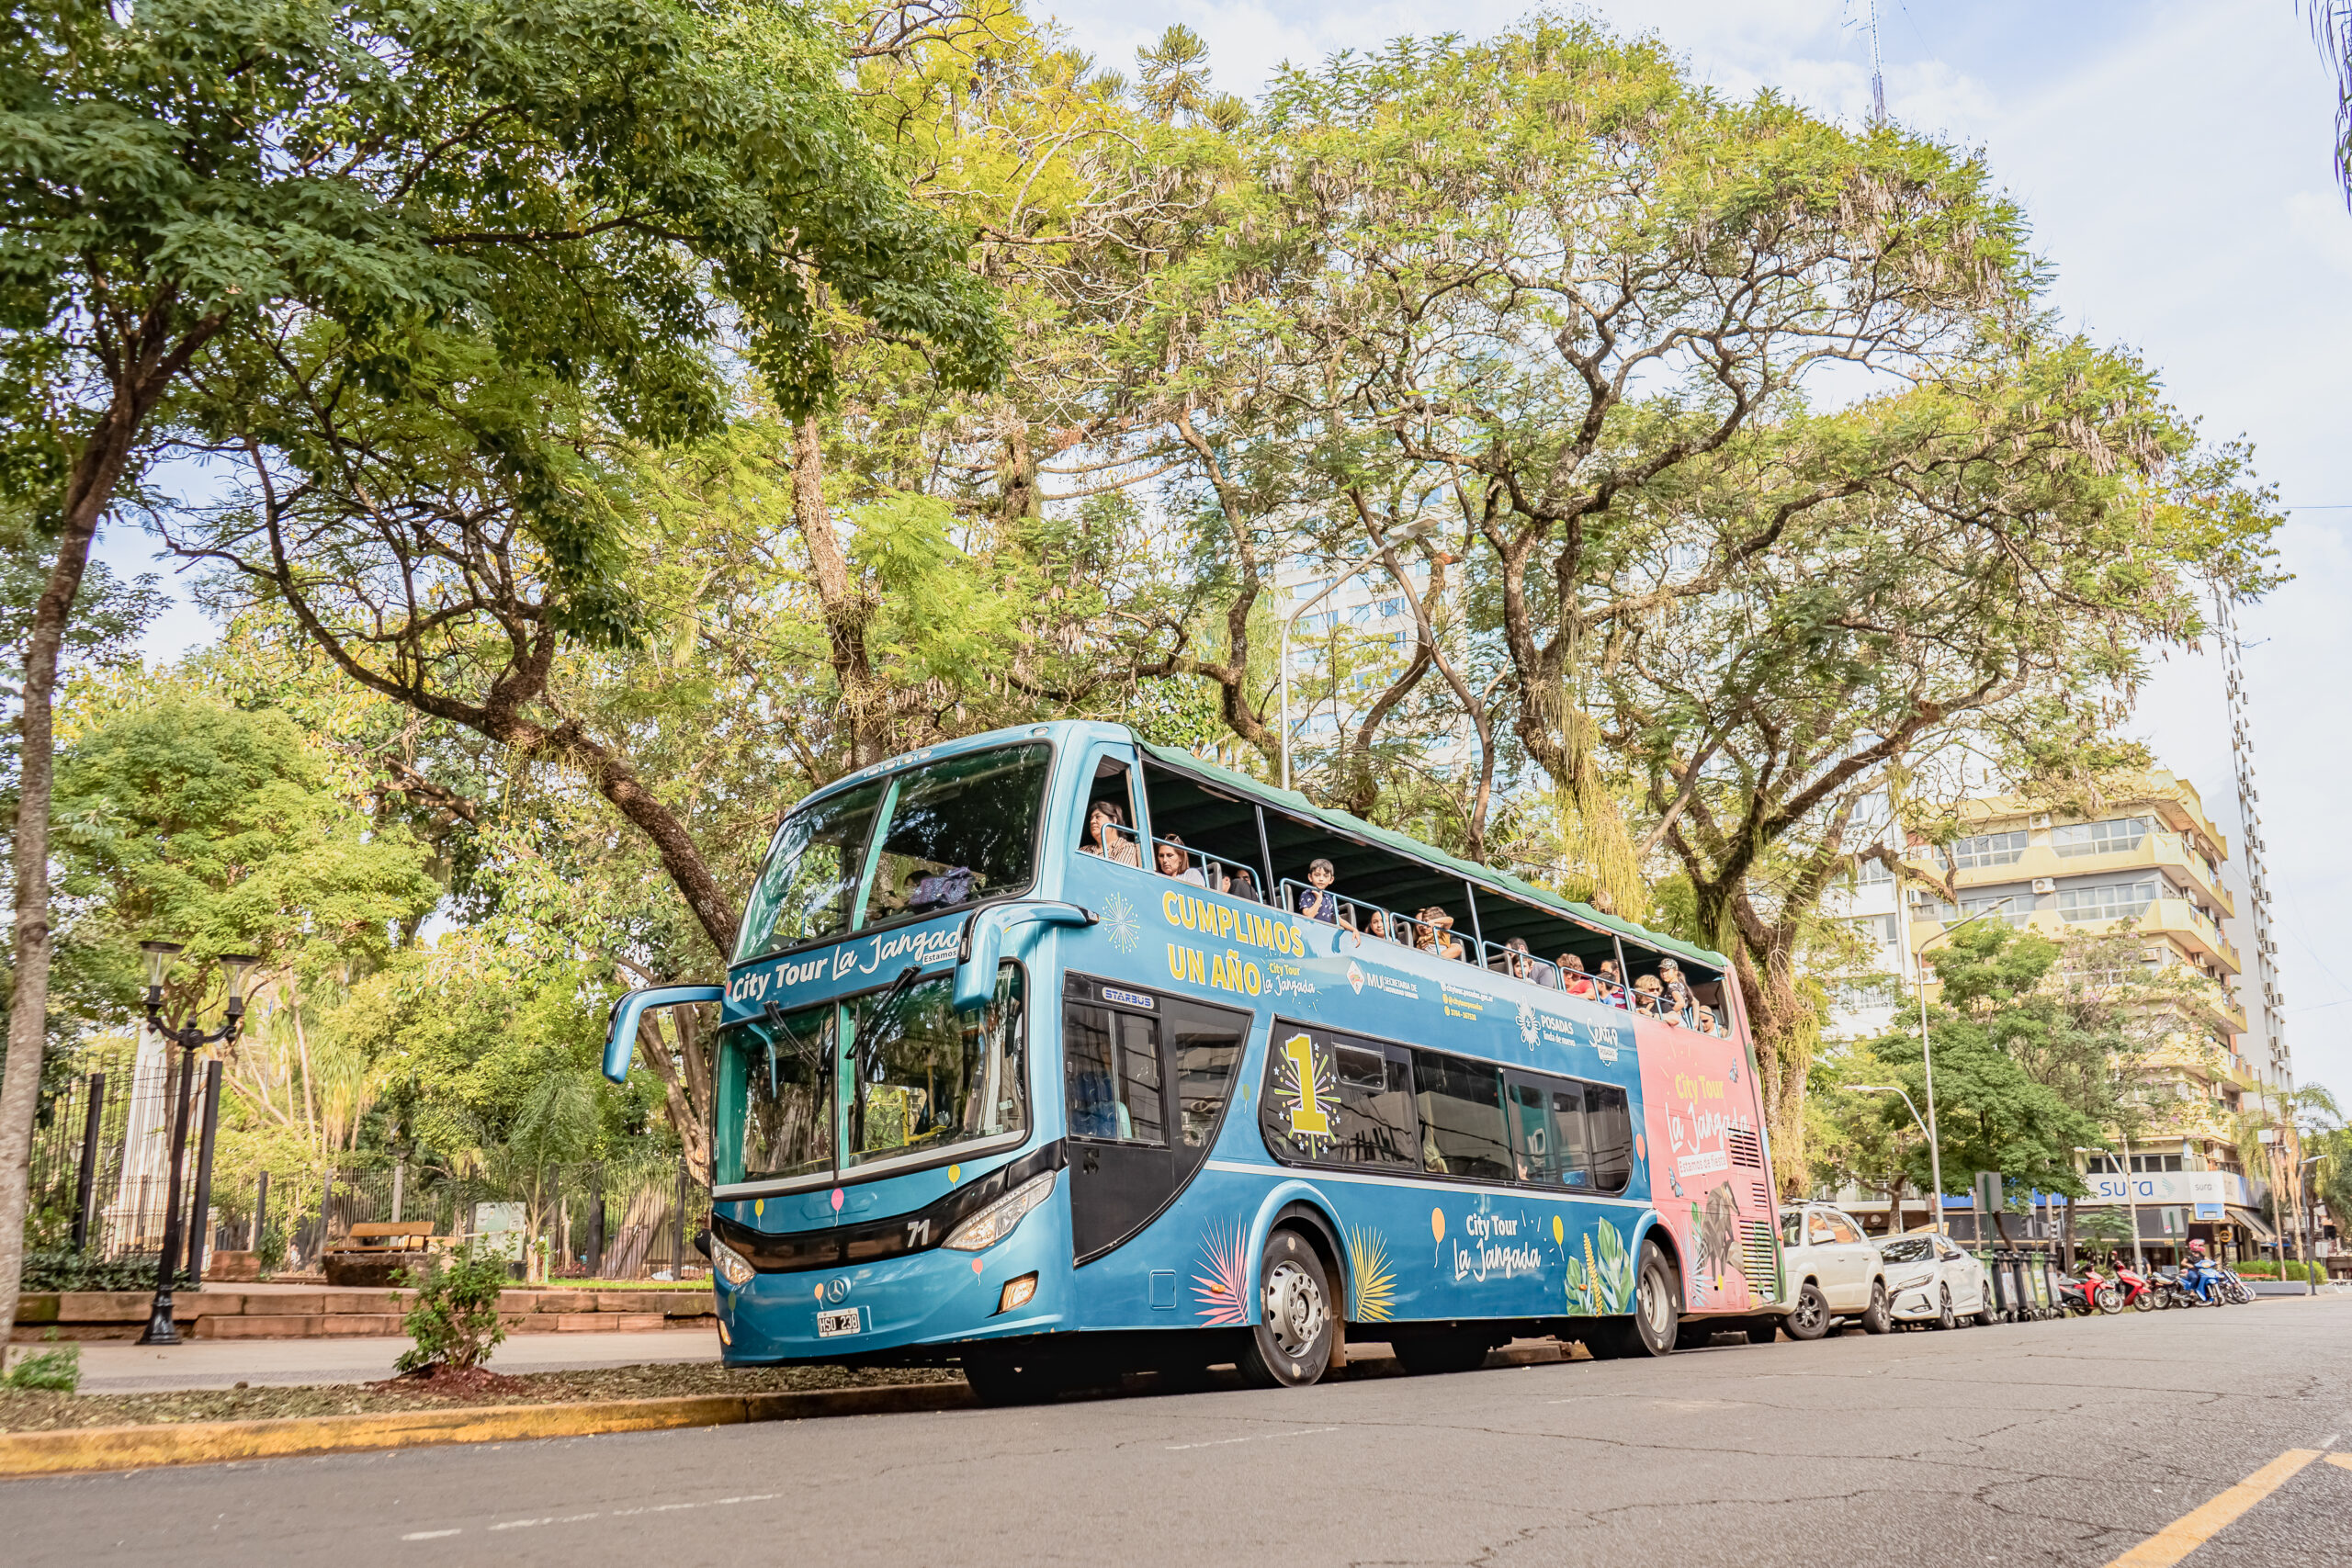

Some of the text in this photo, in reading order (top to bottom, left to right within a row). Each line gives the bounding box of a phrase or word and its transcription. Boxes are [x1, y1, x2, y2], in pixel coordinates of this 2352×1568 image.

[1162, 889, 1306, 958] CUMPLIMOS
[732, 921, 964, 1003] City Tour La Jangad
[923, 950, 957, 963] Estamos
[1167, 942, 1261, 997] UN AÑO
[1269, 962, 1300, 976] City Tour
[1261, 973, 1316, 997] La Jangada
[1366, 972, 1383, 990] MU
[1410, 983, 1419, 993] DE
[1105, 989, 1151, 1007] STARBUS
[1541, 1014, 1574, 1035] POSADAS
[1285, 1032, 1329, 1136] 1
[1675, 1072, 1724, 1105] City Tour
[1665, 1101, 1750, 1155] La Jangada
[2100, 1180, 2153, 1197] sua
[2194, 1182, 2212, 1191] sura
[907, 1219, 931, 1248] 71
[1466, 1213, 1518, 1241] City Tour
[1453, 1237, 1542, 1282] La Jangada
[840, 1314, 858, 1331] 238
